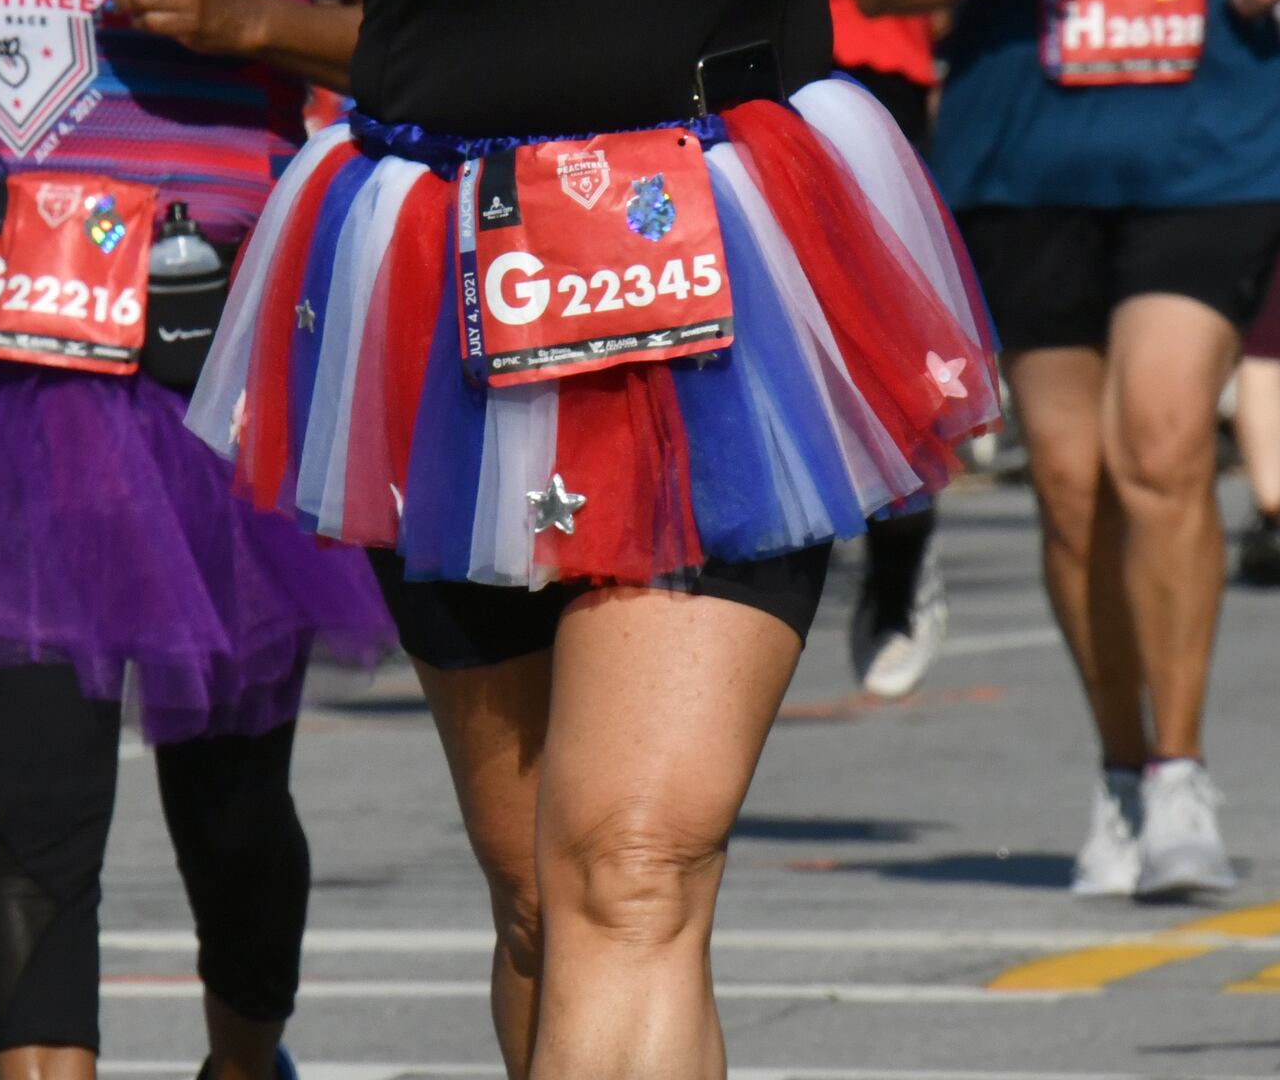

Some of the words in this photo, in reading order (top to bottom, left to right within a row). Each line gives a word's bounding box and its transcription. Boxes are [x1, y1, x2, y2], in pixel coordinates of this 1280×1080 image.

[464, 272, 477, 306] 2021
[468, 307, 479, 322] 4,
[468, 327, 482, 357] JULY
